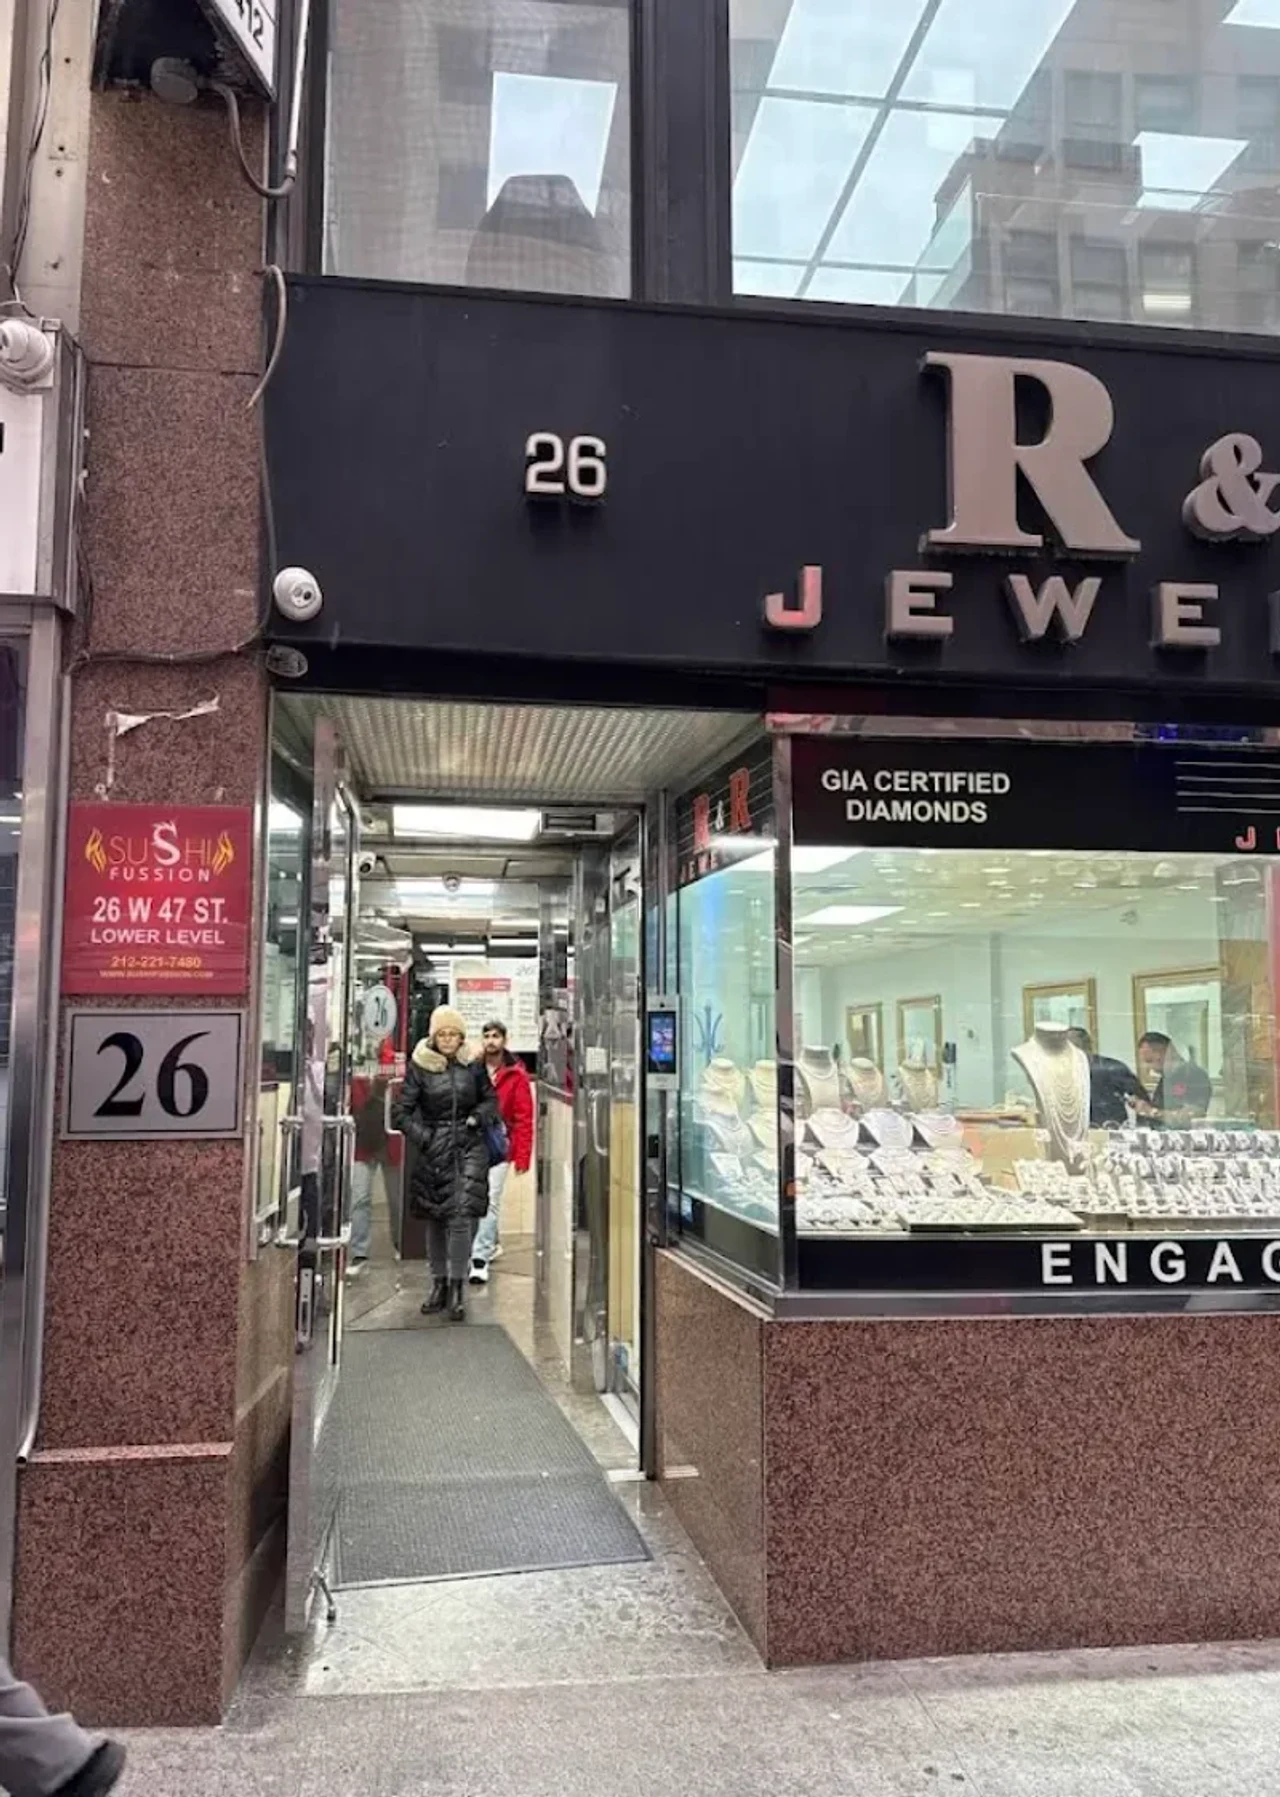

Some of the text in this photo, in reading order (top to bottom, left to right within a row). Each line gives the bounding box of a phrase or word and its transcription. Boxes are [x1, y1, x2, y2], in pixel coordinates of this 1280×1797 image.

[526, 431, 607, 497] 26
[921, 350, 1280, 558] R &
[764, 565, 1280, 655] JEWE
[728, 766, 752, 833] R
[821, 769, 1011, 794] GIA CERTIFIED
[846, 799, 989, 823] DIAMONDS
[107, 820, 212, 866] SUSHI
[109, 866, 210, 882] FUSSION
[92, 896, 229, 924] 26 W 47 ST.
[91, 928, 225, 944] LOWER LEVEL
[93, 1031, 212, 1117] 26
